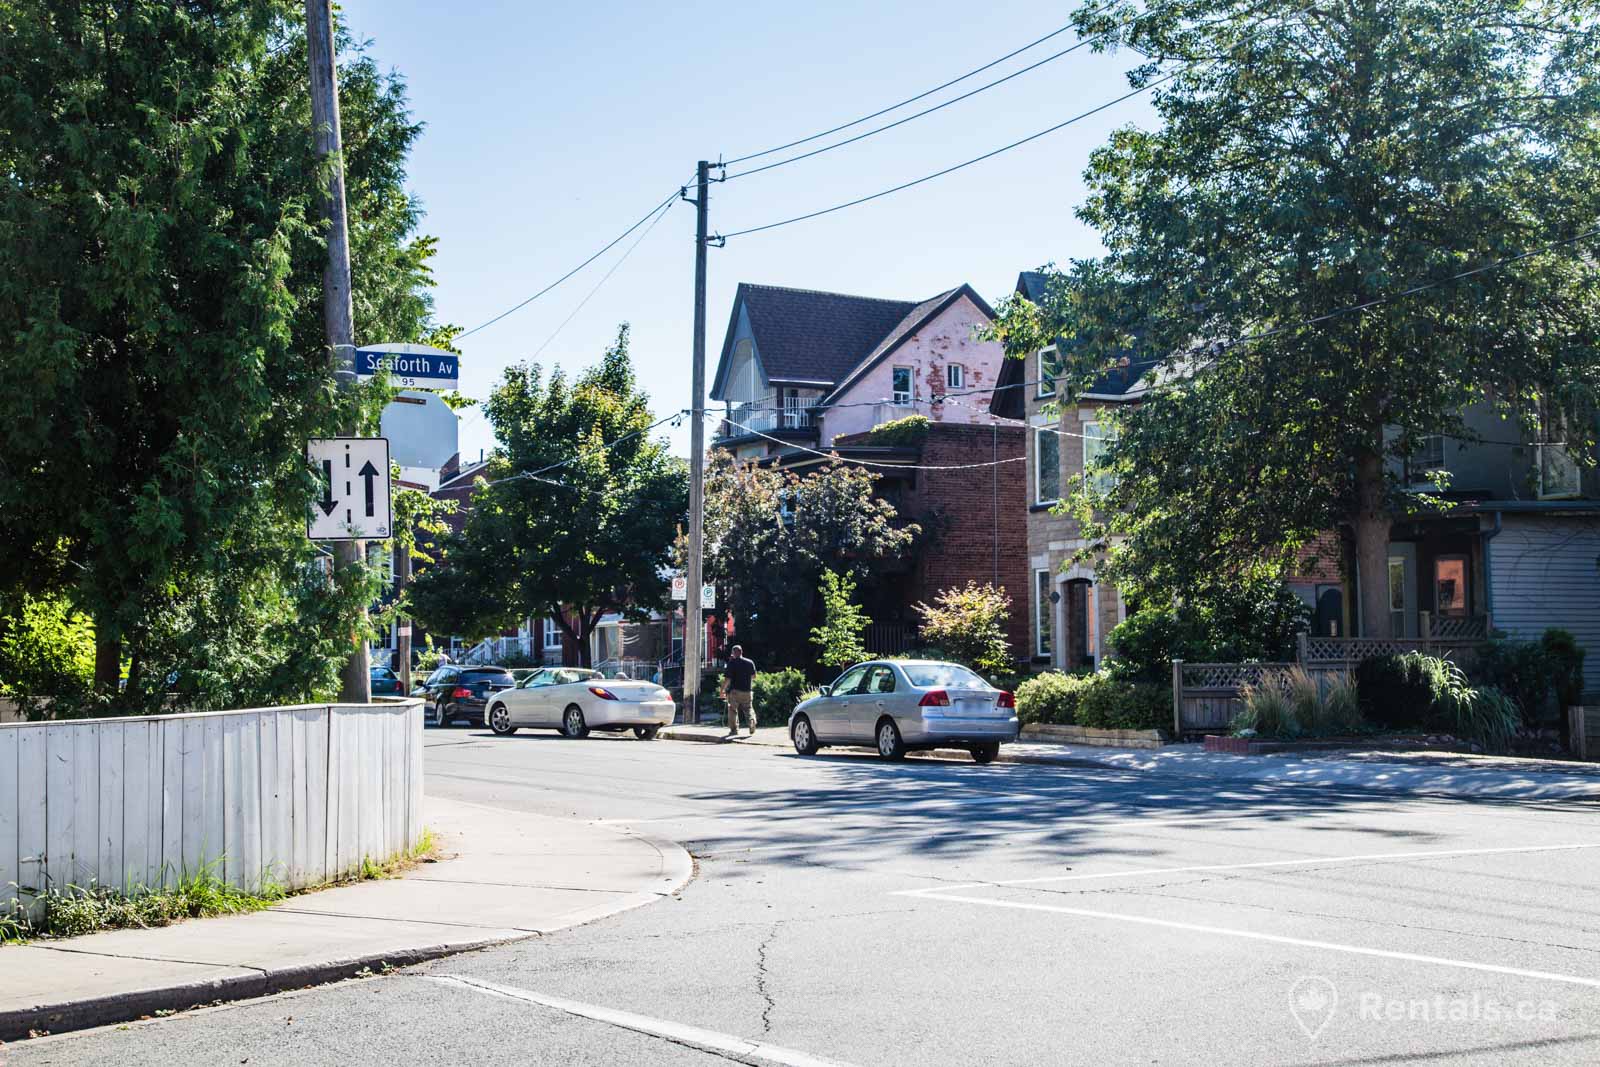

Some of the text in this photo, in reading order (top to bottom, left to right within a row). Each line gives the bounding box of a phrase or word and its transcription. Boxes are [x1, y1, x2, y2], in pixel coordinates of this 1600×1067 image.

[367, 354, 452, 375] Seaforth Av
[402, 377, 415, 386] 95
